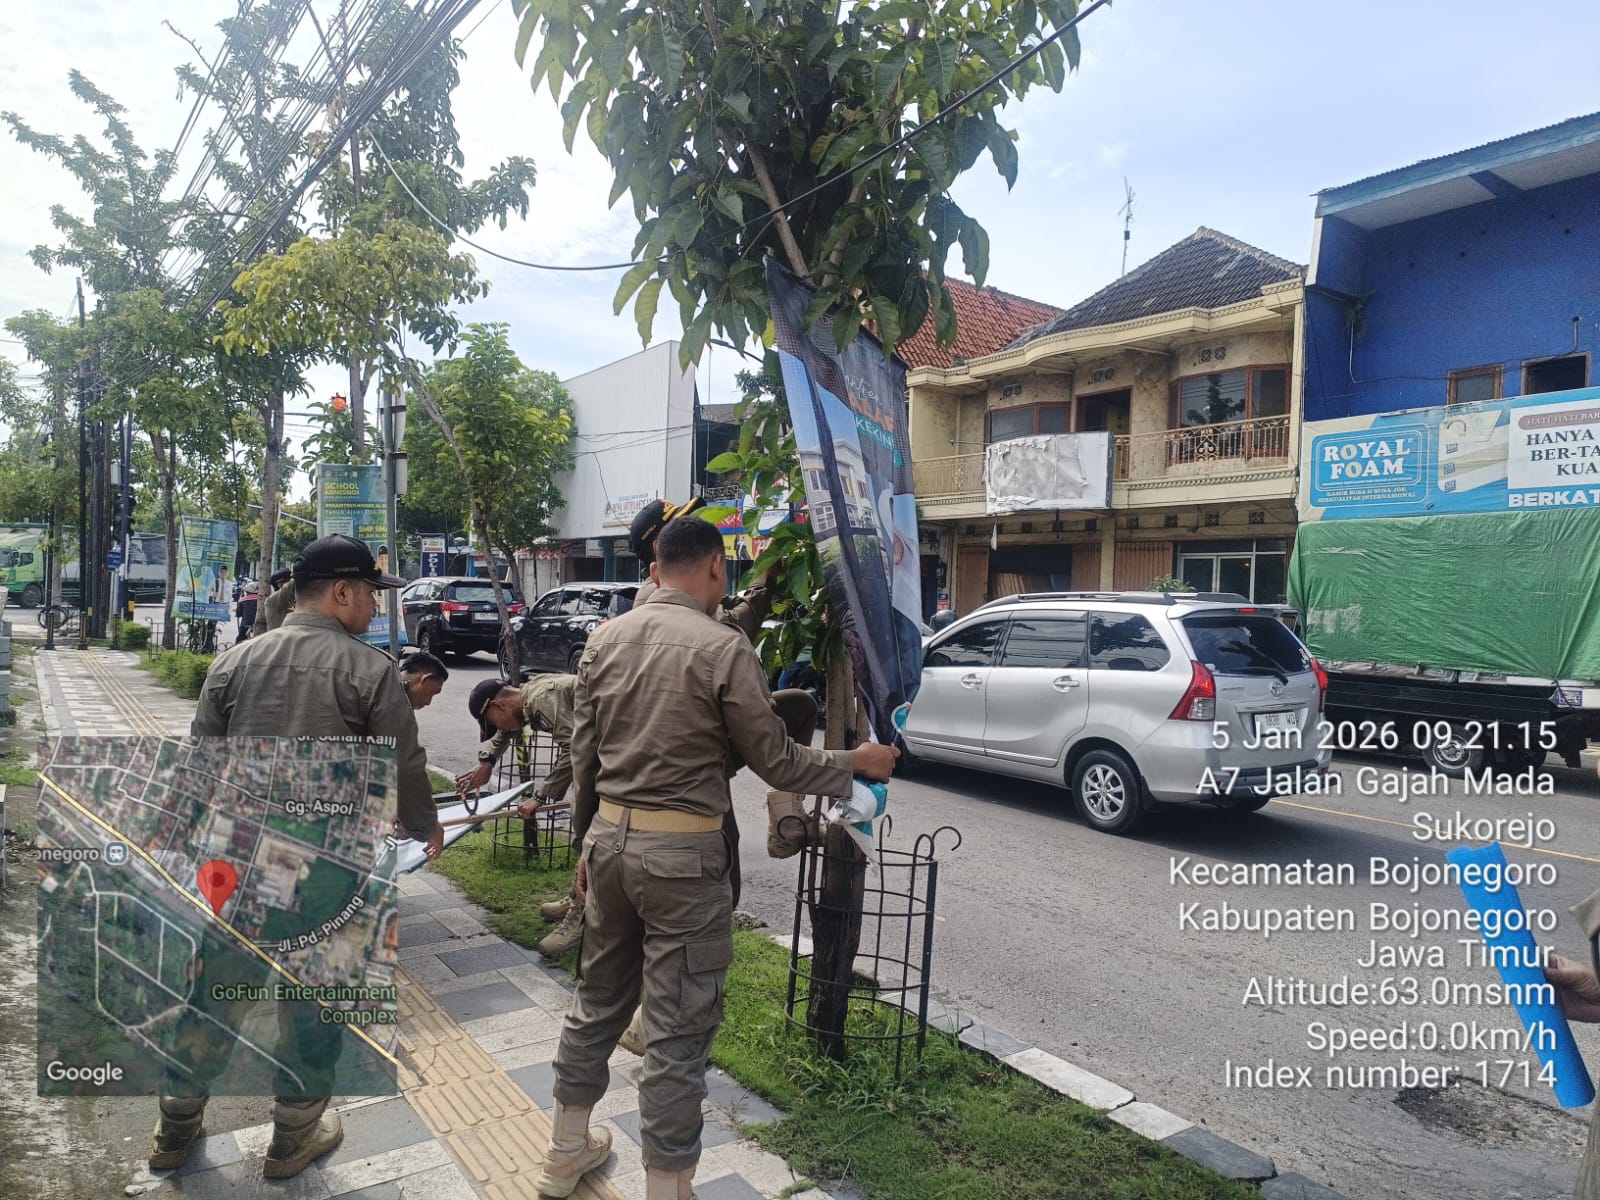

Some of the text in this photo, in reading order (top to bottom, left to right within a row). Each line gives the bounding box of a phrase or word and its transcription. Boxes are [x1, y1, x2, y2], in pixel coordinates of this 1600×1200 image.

[1526, 428, 1595, 446] HANYA
[1323, 438, 1411, 462] ROYAL
[1530, 444, 1600, 462] BER-TA
[1330, 457, 1405, 480] FOAM
[1556, 462, 1599, 477] KUA
[324, 482, 359, 490] SCHOOL
[1508, 488, 1600, 508] BERKAT
